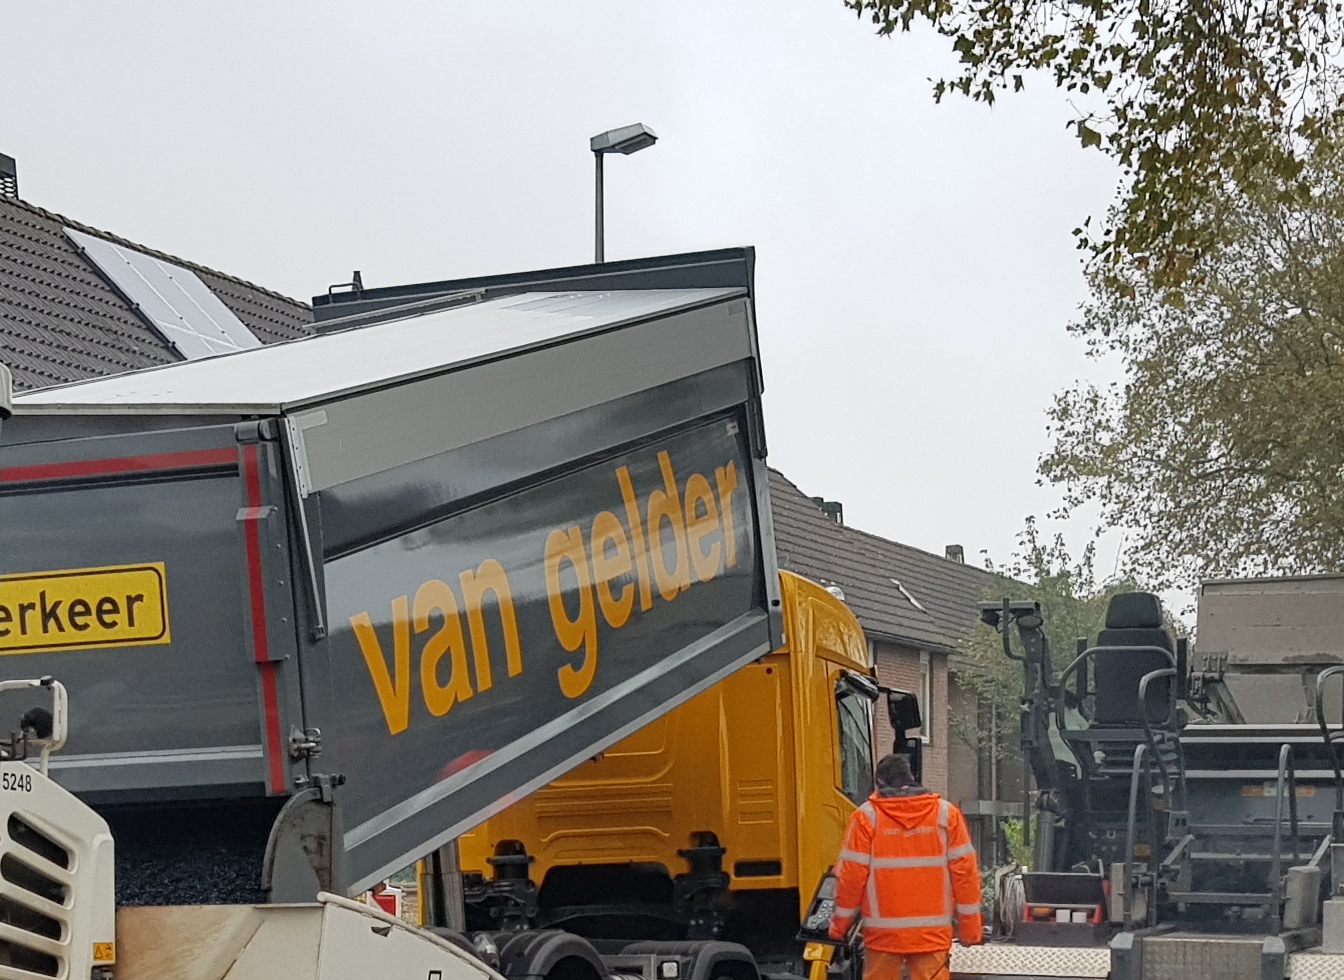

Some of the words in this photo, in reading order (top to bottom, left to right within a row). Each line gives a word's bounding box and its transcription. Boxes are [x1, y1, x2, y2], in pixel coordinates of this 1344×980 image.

[349, 558, 523, 735] van
[544, 450, 738, 698] gelder
[2, 772, 32, 792] 5248
